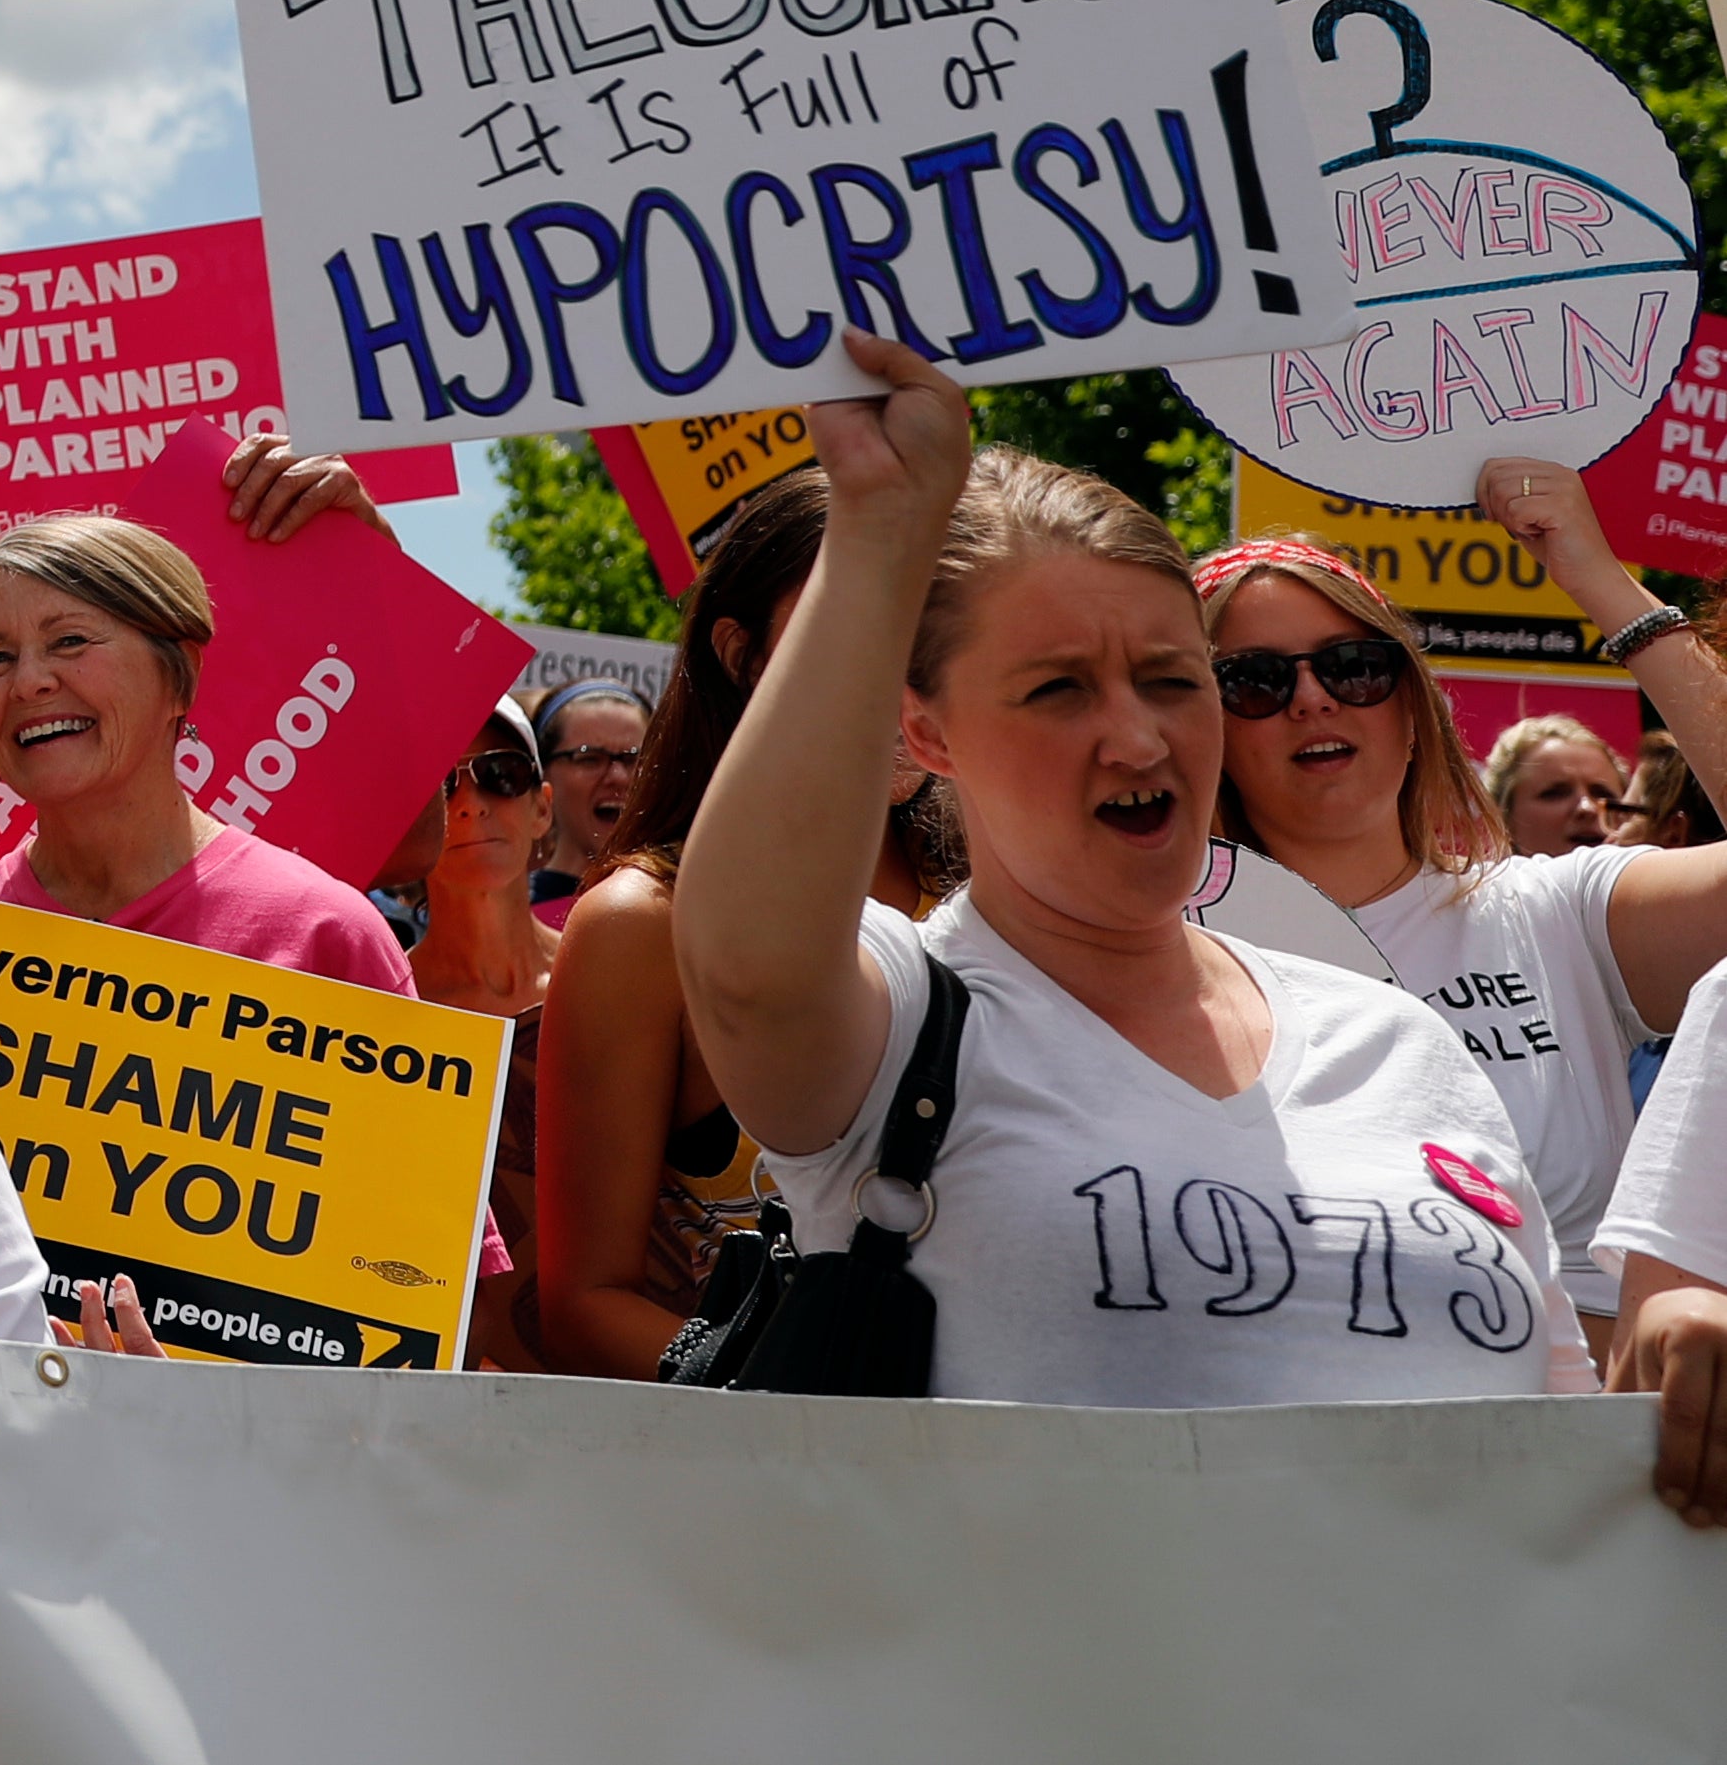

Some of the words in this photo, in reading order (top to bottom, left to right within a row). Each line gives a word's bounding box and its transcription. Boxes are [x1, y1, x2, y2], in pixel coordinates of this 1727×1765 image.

[460, 100, 563, 189] It
[719, 48, 882, 135] Full
[943, 15, 1022, 112] of
[323, 47, 1302, 422] HYPOCRISY!
[1270, 290, 1669, 450] AGAIN
[705, 448, 748, 490] on
[745, 410, 807, 458] YO
[1416, 537, 1547, 590] YOU
[1463, 627, 1539, 654] people
[1541, 630, 1577, 654] die
[220, 993, 475, 1098] Parson
[1462, 1019, 1561, 1062] ALE
[99, 1141, 323, 1257] YOU
[1072, 1163, 1534, 1354] 1973
[152, 1295, 281, 1346] people
[287, 1324, 346, 1364] die
